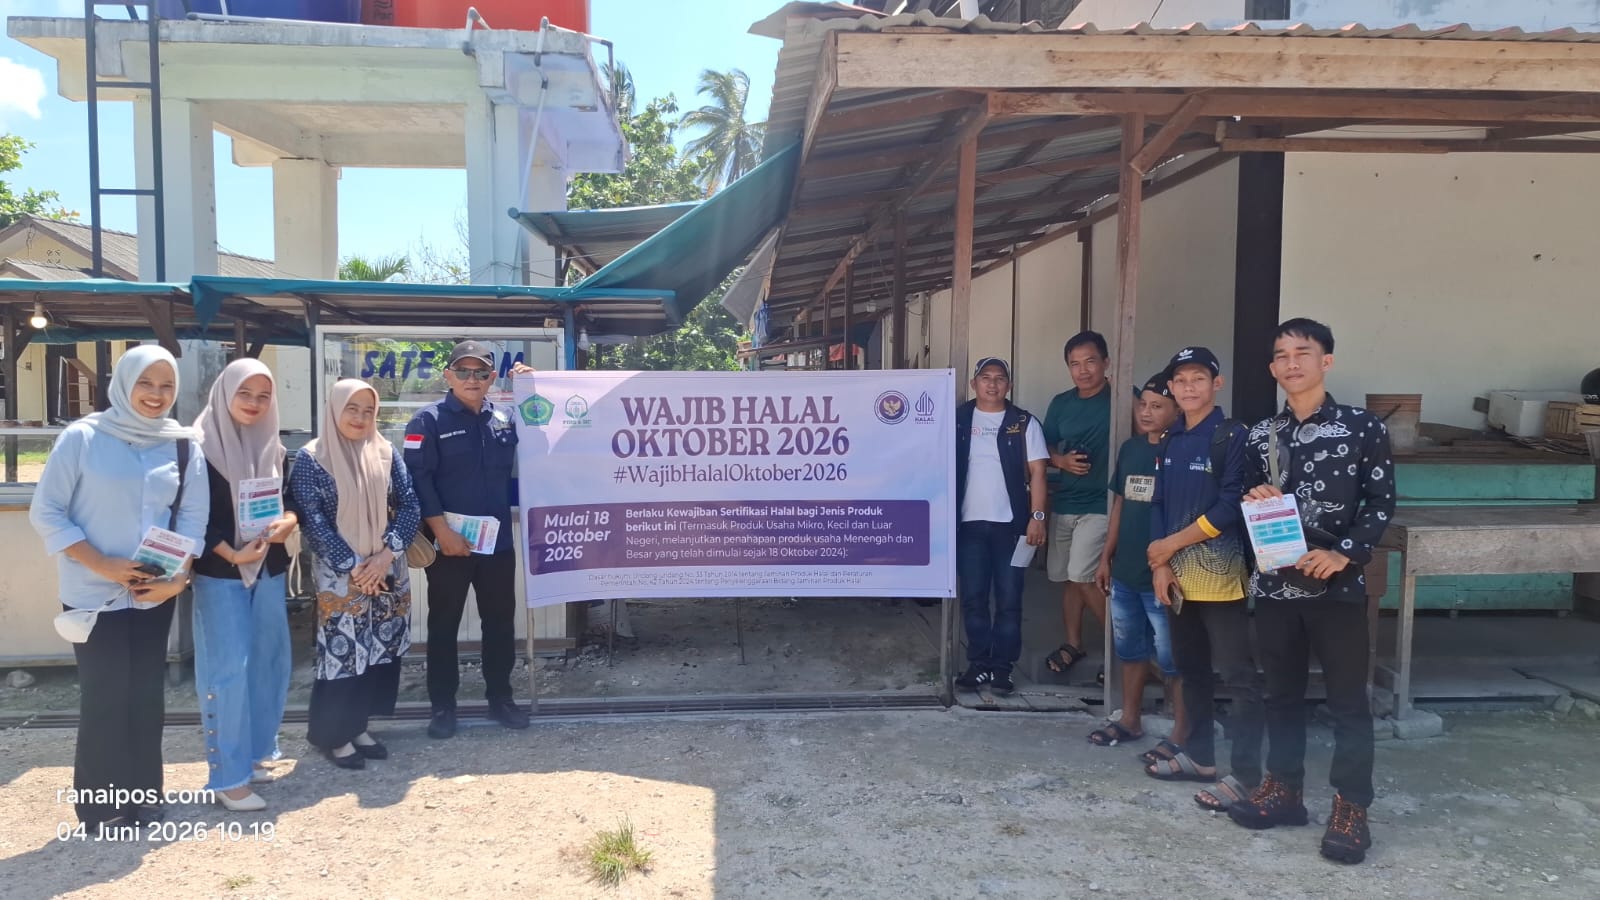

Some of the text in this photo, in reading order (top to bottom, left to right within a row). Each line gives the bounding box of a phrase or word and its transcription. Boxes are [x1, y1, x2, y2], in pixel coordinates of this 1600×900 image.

[361, 350, 436, 380] SATE
[621, 396, 840, 425] WAJIB HALAL
[612, 427, 849, 458] OKTOBER 2026
[613, 463, 847, 487] #WajibHalalOktober2026
[544, 511, 610, 528] Mulai 18
[626, 507, 883, 520] Berlaku Kewajiban Sertifikasi Halal bagi Jenis Produk
[626, 522, 662, 532] berikut
[664, 522, 677, 531] ini
[730, 521, 763, 530] Produk
[766, 521, 795, 530] Usaha
[797, 521, 825, 531] Mikro,
[827, 520, 850, 530] Kecil
[851, 520, 869, 530] dan
[872, 521, 893, 530] Luar
[545, 528, 611, 545] Oktober
[626, 534, 914, 547] Negeri, melanjutkan penahapan produk usaha Menengah dan
[545, 546, 583, 562] 2026
[626, 547, 848, 562] Besar yang telah dimulai sejak 18 Oktober 2024):
